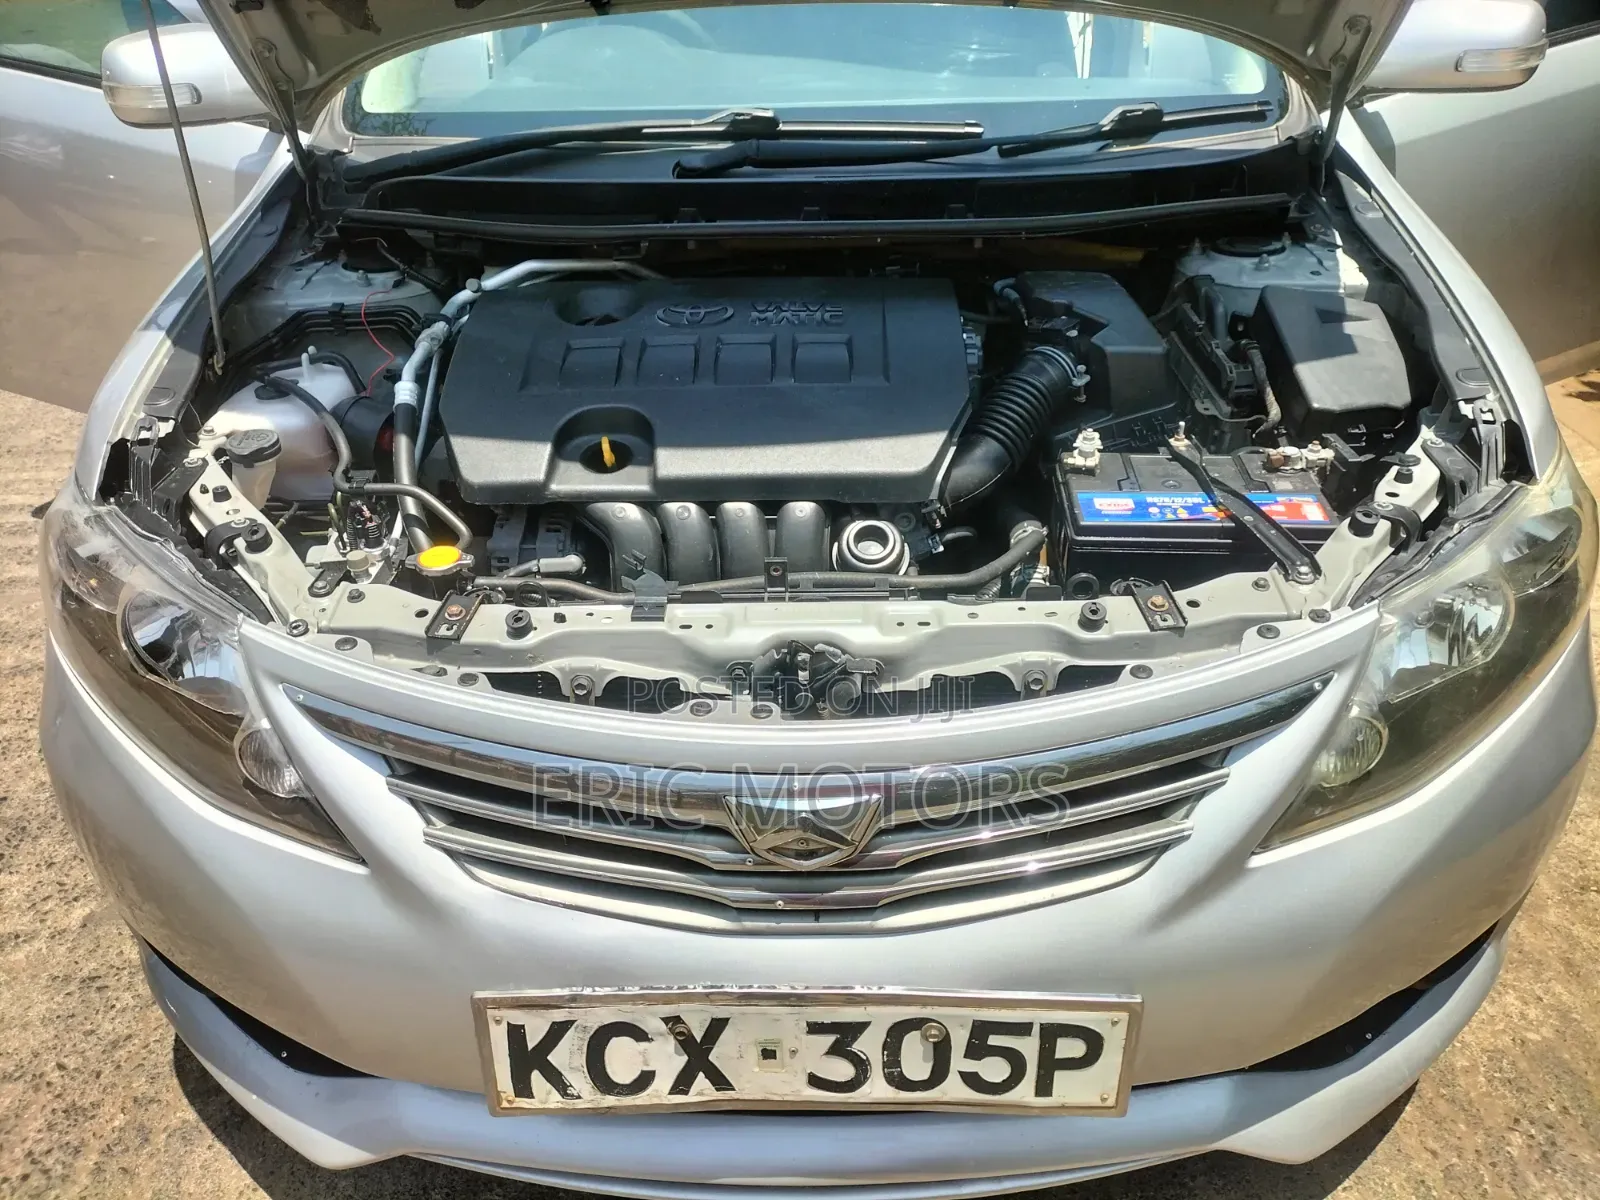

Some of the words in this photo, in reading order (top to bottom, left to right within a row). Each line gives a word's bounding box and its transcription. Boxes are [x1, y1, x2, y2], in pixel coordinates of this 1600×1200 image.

[750, 311, 843, 326] MATIC
[506, 1015, 737, 1099] KCX
[805, 1017, 1106, 1099] 305P
